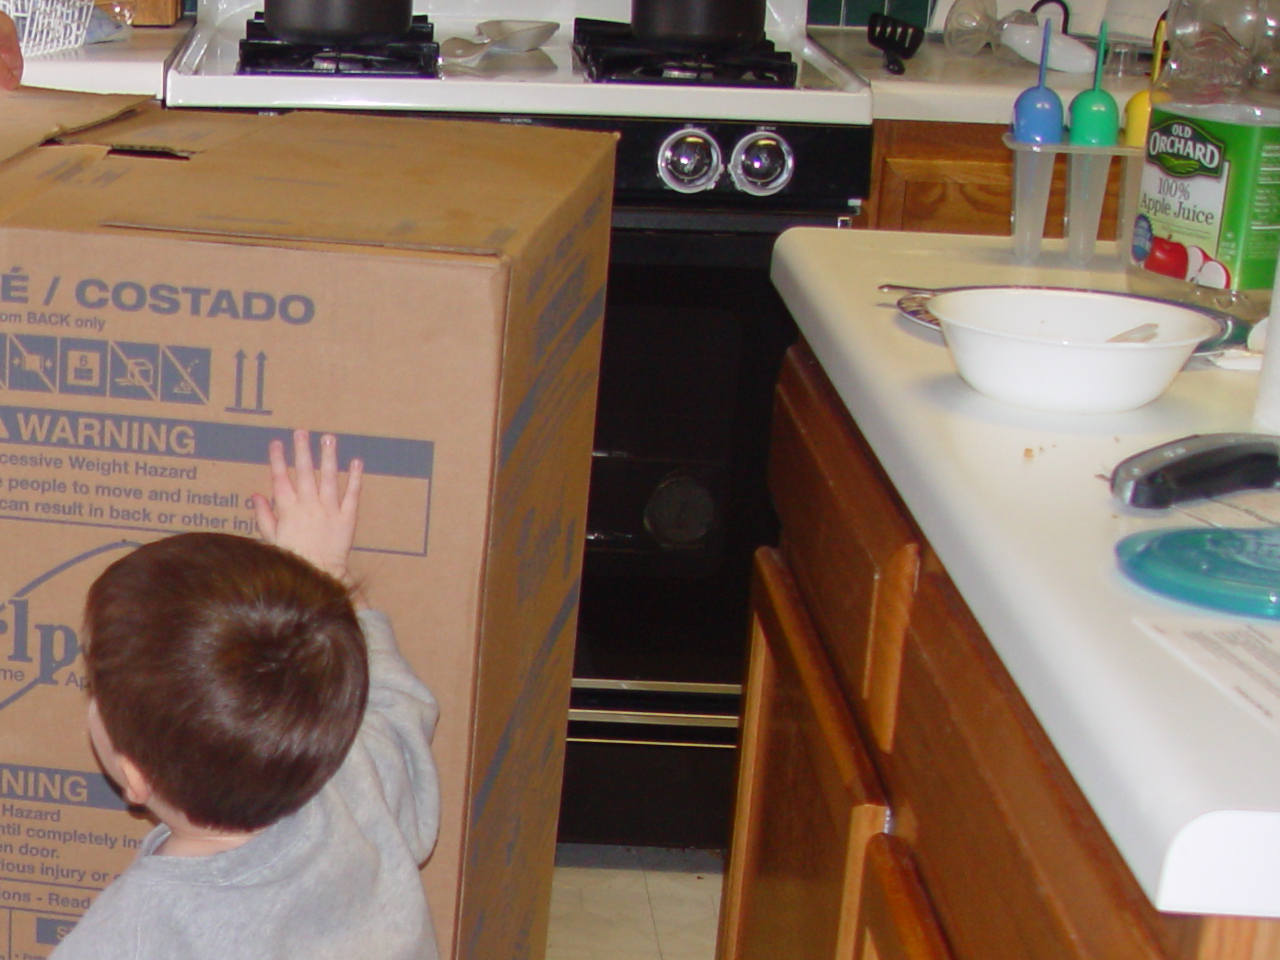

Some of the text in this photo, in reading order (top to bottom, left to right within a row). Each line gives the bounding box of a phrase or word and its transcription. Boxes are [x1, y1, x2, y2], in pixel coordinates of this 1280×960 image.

[1171, 124, 1193, 138] OLD
[1149, 131, 1220, 168] ORCHARD
[1158, 178, 1191, 201] 100%
[1140, 192, 1214, 225] Apple Juice
[43, 276, 60, 306] /
[75, 278, 315, 325] COSTADO
[27, 312, 70, 327] BACK
[75, 317, 106, 332] only
[17, 413, 195, 454] WARNING
[69, 455, 129, 476] Weight
[134, 461, 197, 480] Hazard
[8, 477, 67, 494] people
[72, 481, 89, 495] to
[95, 483, 143, 499] move
[148, 488, 180, 503] and
[187, 491, 239, 508] install
[35, 502, 83, 516] result
[88, 503, 104, 518] in
[110, 506, 151, 523] back
[158, 511, 175, 524] or
[181, 513, 229, 530] other
[2, 804, 61, 823] Hazard
[26, 827, 118, 849] completely
[18, 843, 60, 859] door.
[40, 863, 86, 882] injury
[91, 871, 109, 882] or
[48, 892, 91, 910] Read
